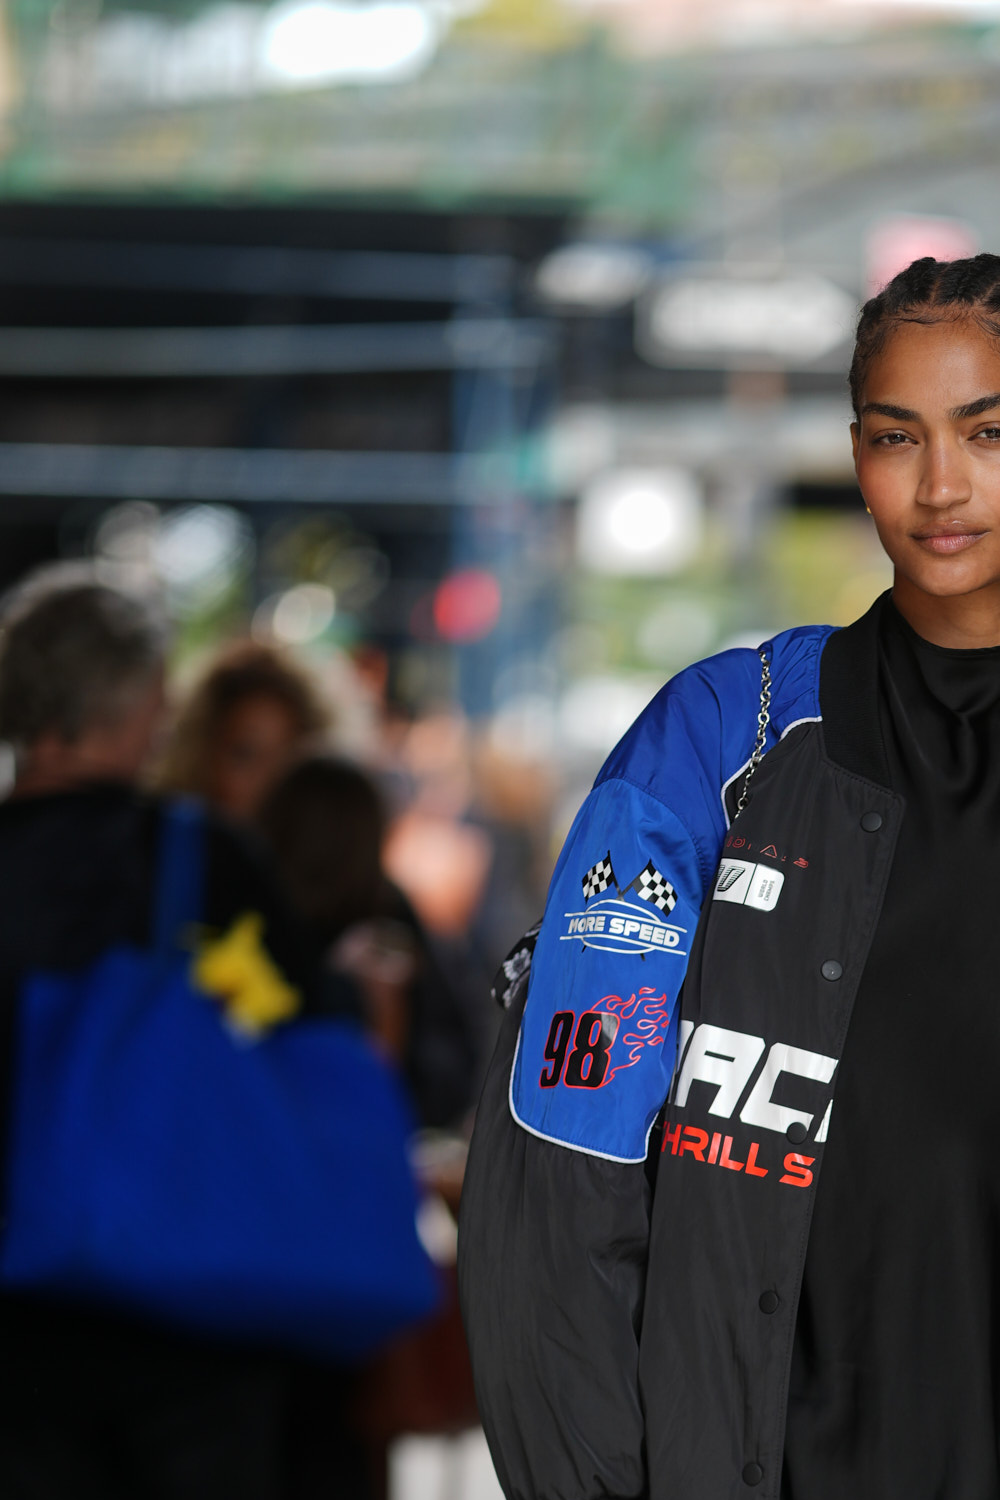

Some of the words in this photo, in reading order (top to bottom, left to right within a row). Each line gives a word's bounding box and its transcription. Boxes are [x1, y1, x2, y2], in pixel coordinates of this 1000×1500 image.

[567, 916, 606, 934] MORE
[608, 917, 680, 948] SPEED
[539, 1009, 621, 1091] 98
[660, 1120, 769, 1178] HRILL
